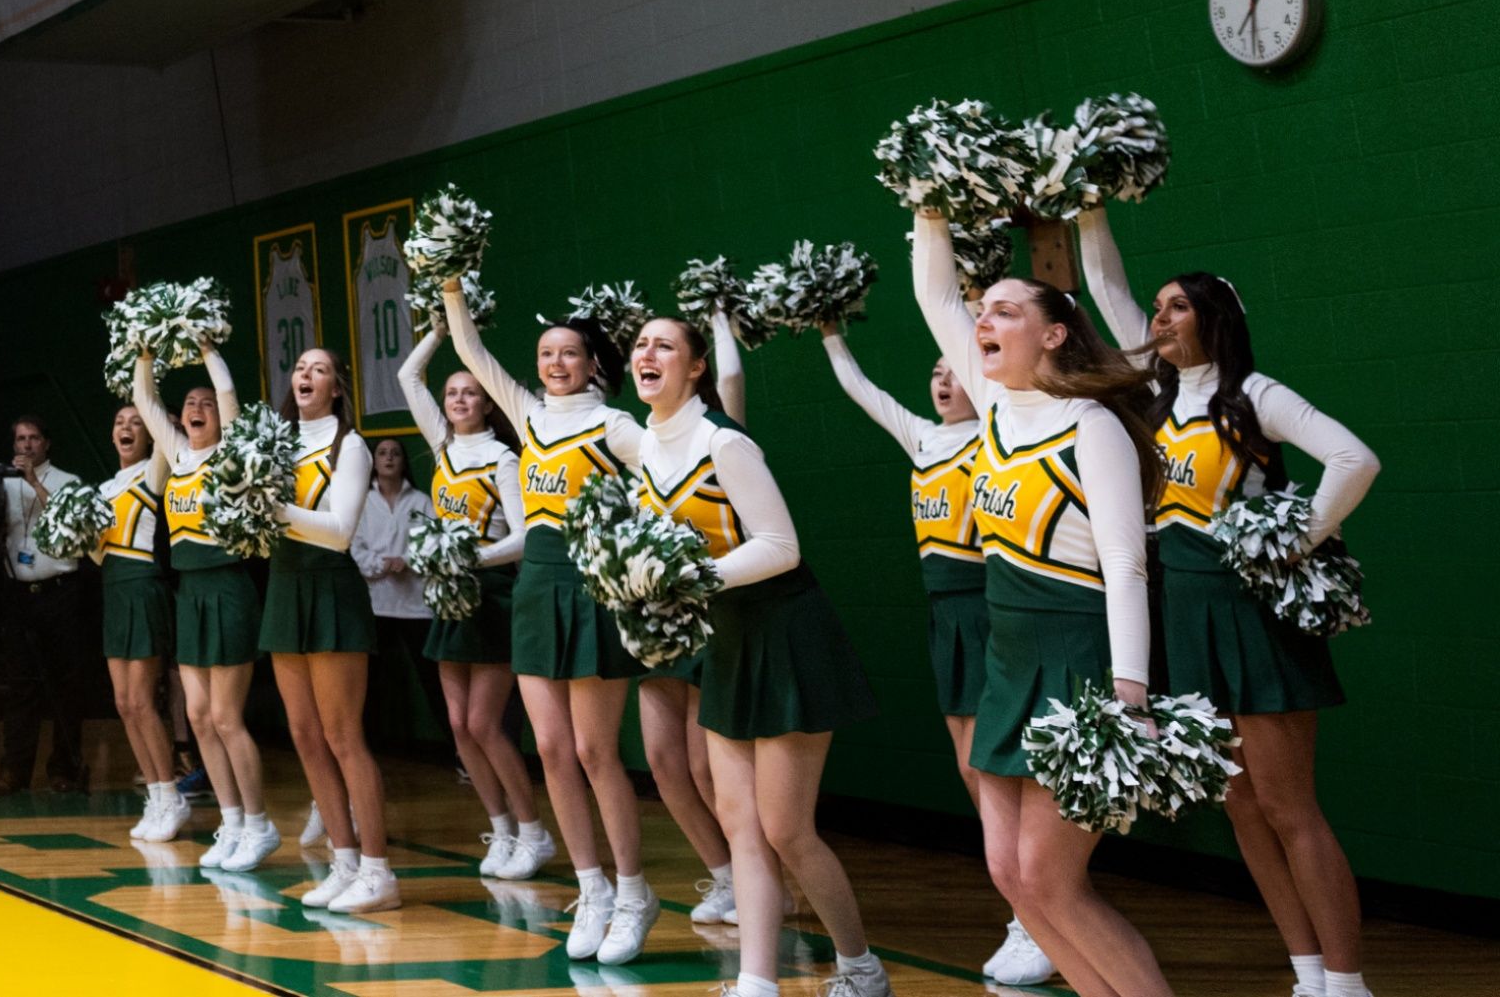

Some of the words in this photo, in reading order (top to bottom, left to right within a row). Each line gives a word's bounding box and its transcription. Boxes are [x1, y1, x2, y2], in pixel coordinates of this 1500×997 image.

[278, 316, 305, 373] 30
[372, 299, 399, 360] 10
[526, 463, 568, 495] Irish
[973, 475, 1016, 520] Irish
[168, 489, 198, 513] Irish
[438, 486, 469, 516] Irish
